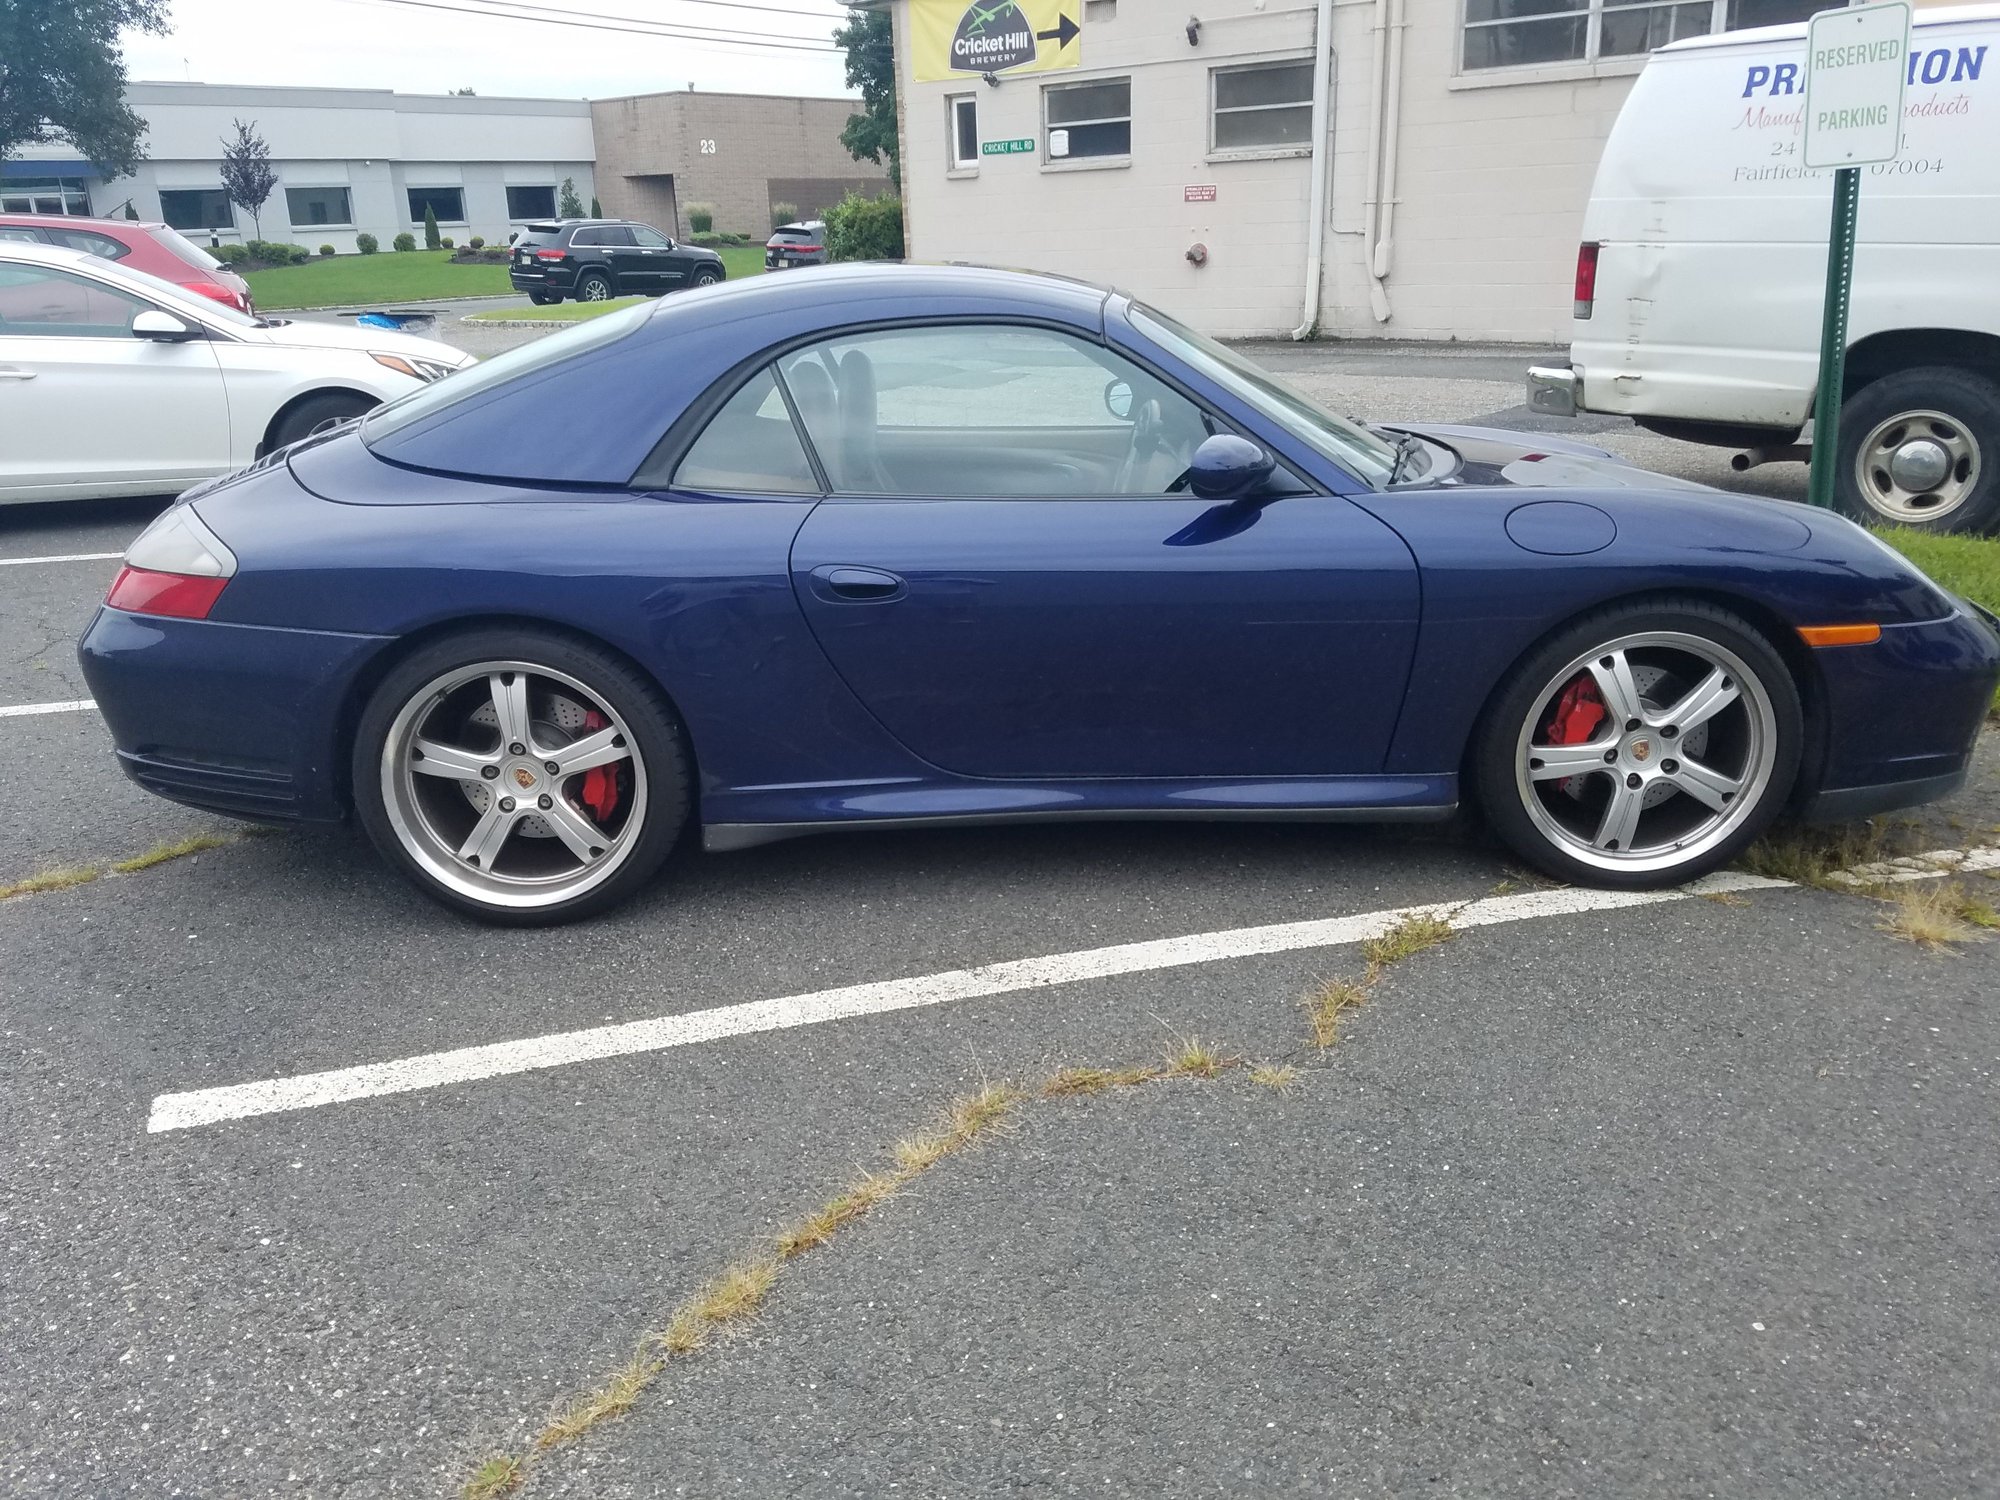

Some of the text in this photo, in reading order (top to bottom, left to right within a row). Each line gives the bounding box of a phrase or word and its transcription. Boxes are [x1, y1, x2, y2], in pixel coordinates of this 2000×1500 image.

[955, 31, 1028, 56] Cricket Hill
[970, 53, 1016, 65] BREWERY
[1815, 39, 1899, 70] RESERVED
[1742, 46, 1988, 98] PRION
[1818, 104, 1888, 131] PARKING
[700, 139, 716, 154] 23
[984, 140, 1033, 153] CRICKET HILL RD
[1770, 141, 1796, 156] 24
[1871, 158, 1944, 176] 07004
